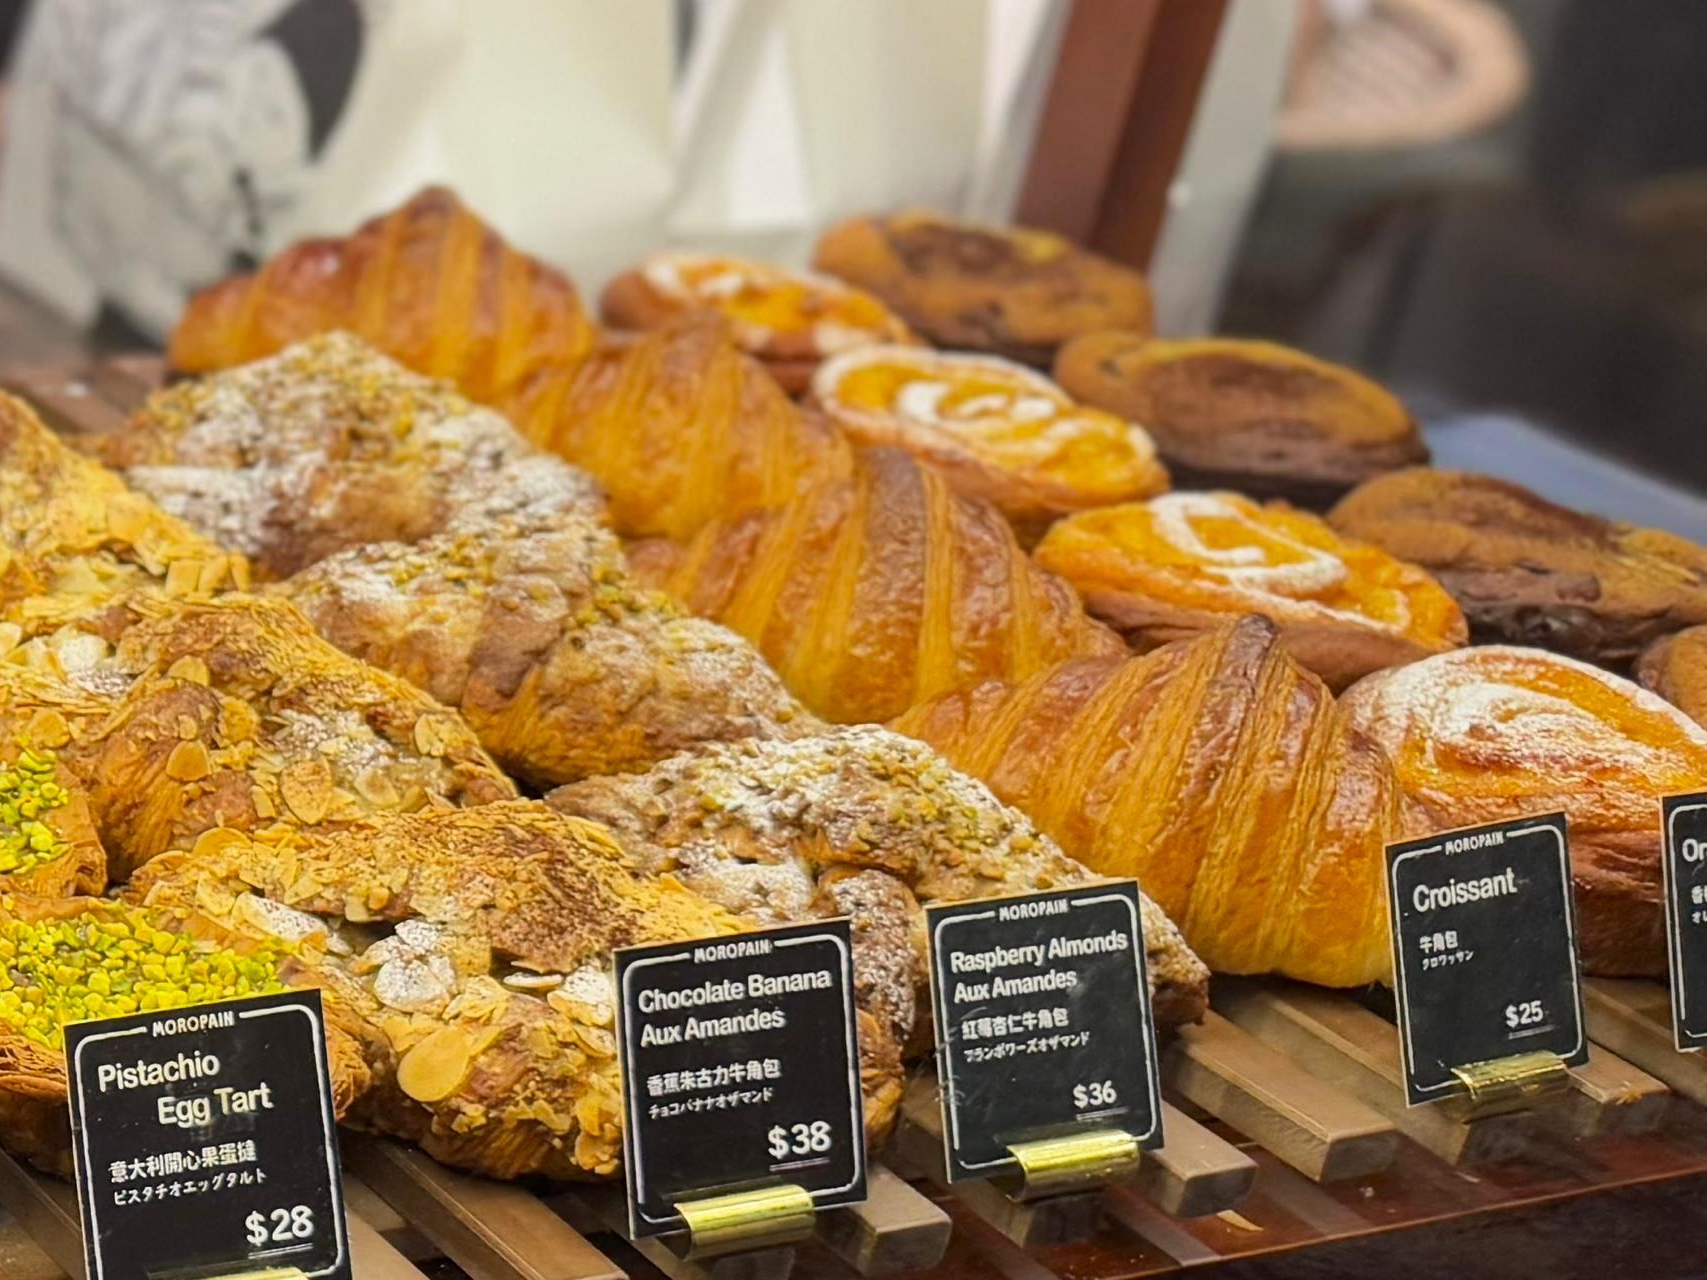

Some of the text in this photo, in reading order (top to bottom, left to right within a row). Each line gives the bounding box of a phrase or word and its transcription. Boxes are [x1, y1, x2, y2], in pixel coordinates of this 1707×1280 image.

[1445, 831, 1505, 855] MOROPAIN
[999, 898, 1069, 921] MOROPAIN
[1413, 867, 1518, 913] Croissant
[693, 939, 773, 963] MOROPAIN
[950, 930, 1129, 973] Raspberry Almonds
[638, 969, 833, 1014] Chocolate Banana
[954, 969, 1077, 1004] Aux Amandes
[152, 1010, 235, 1037] MOROPAIN
[640, 1007, 787, 1048] Aux Amandes
[1505, 1000, 1544, 1027] $25
[98, 1050, 221, 1093] Pistachio
[158, 1082, 274, 1128] Egg Tart
[1073, 1080, 1117, 1108] $36
[768, 1120, 832, 1159] $38
[245, 1204, 315, 1246] $28
